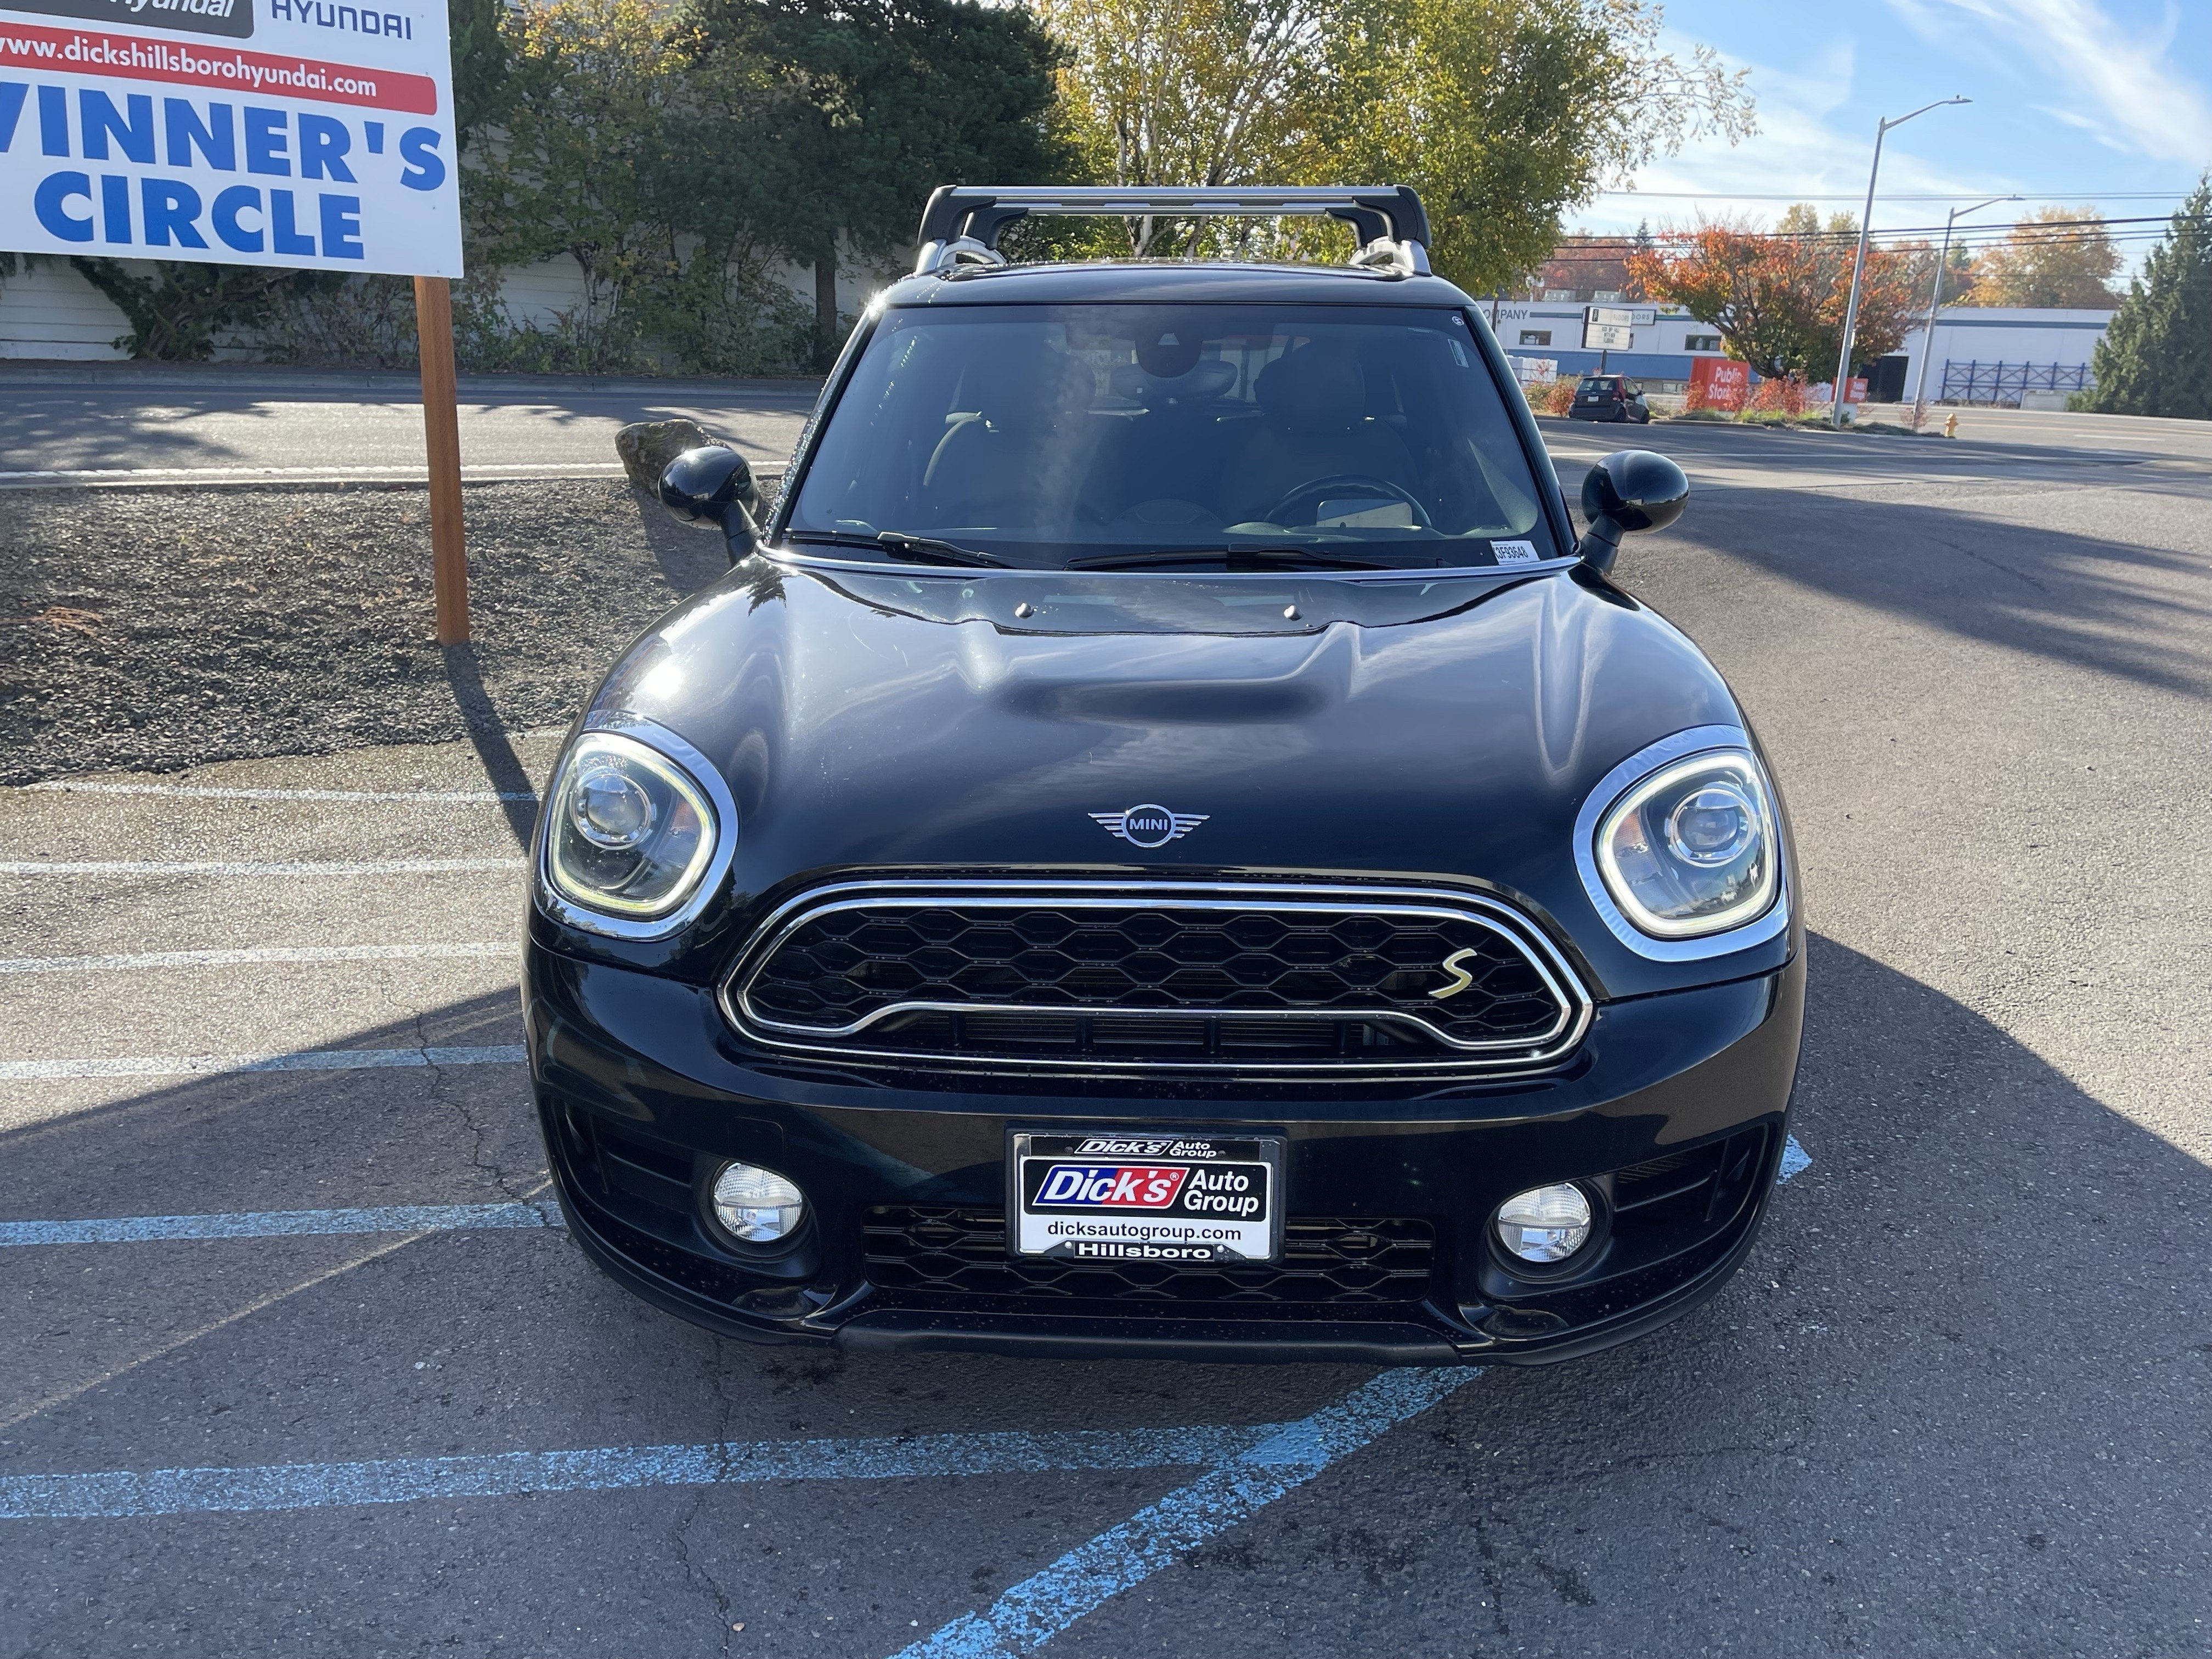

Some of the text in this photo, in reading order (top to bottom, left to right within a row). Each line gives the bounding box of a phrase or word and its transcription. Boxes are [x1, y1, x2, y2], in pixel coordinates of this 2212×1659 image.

[111, 0, 234, 18] yundai
[272, 0, 411, 40] HYUNDAI
[0, 36, 377, 97] ww.dickshillsborohyundai.com
[34, 171, 364, 259] CIRCLE
[1130, 818, 1168, 831] MINI
[1428, 947, 1477, 999] S
[1081, 1141, 1163, 1153] Dick's
[1169, 1148, 1217, 1159] Group
[1173, 1141, 1211, 1150] Auto
[1043, 1170, 1170, 1203] Dick's
[1188, 1170, 1249, 1192] Auto
[1184, 1190, 1259, 1216] Group
[1047, 1222, 1242, 1240] dicksautogroup.com
[1078, 1243, 1211, 1259] Hillsboro
